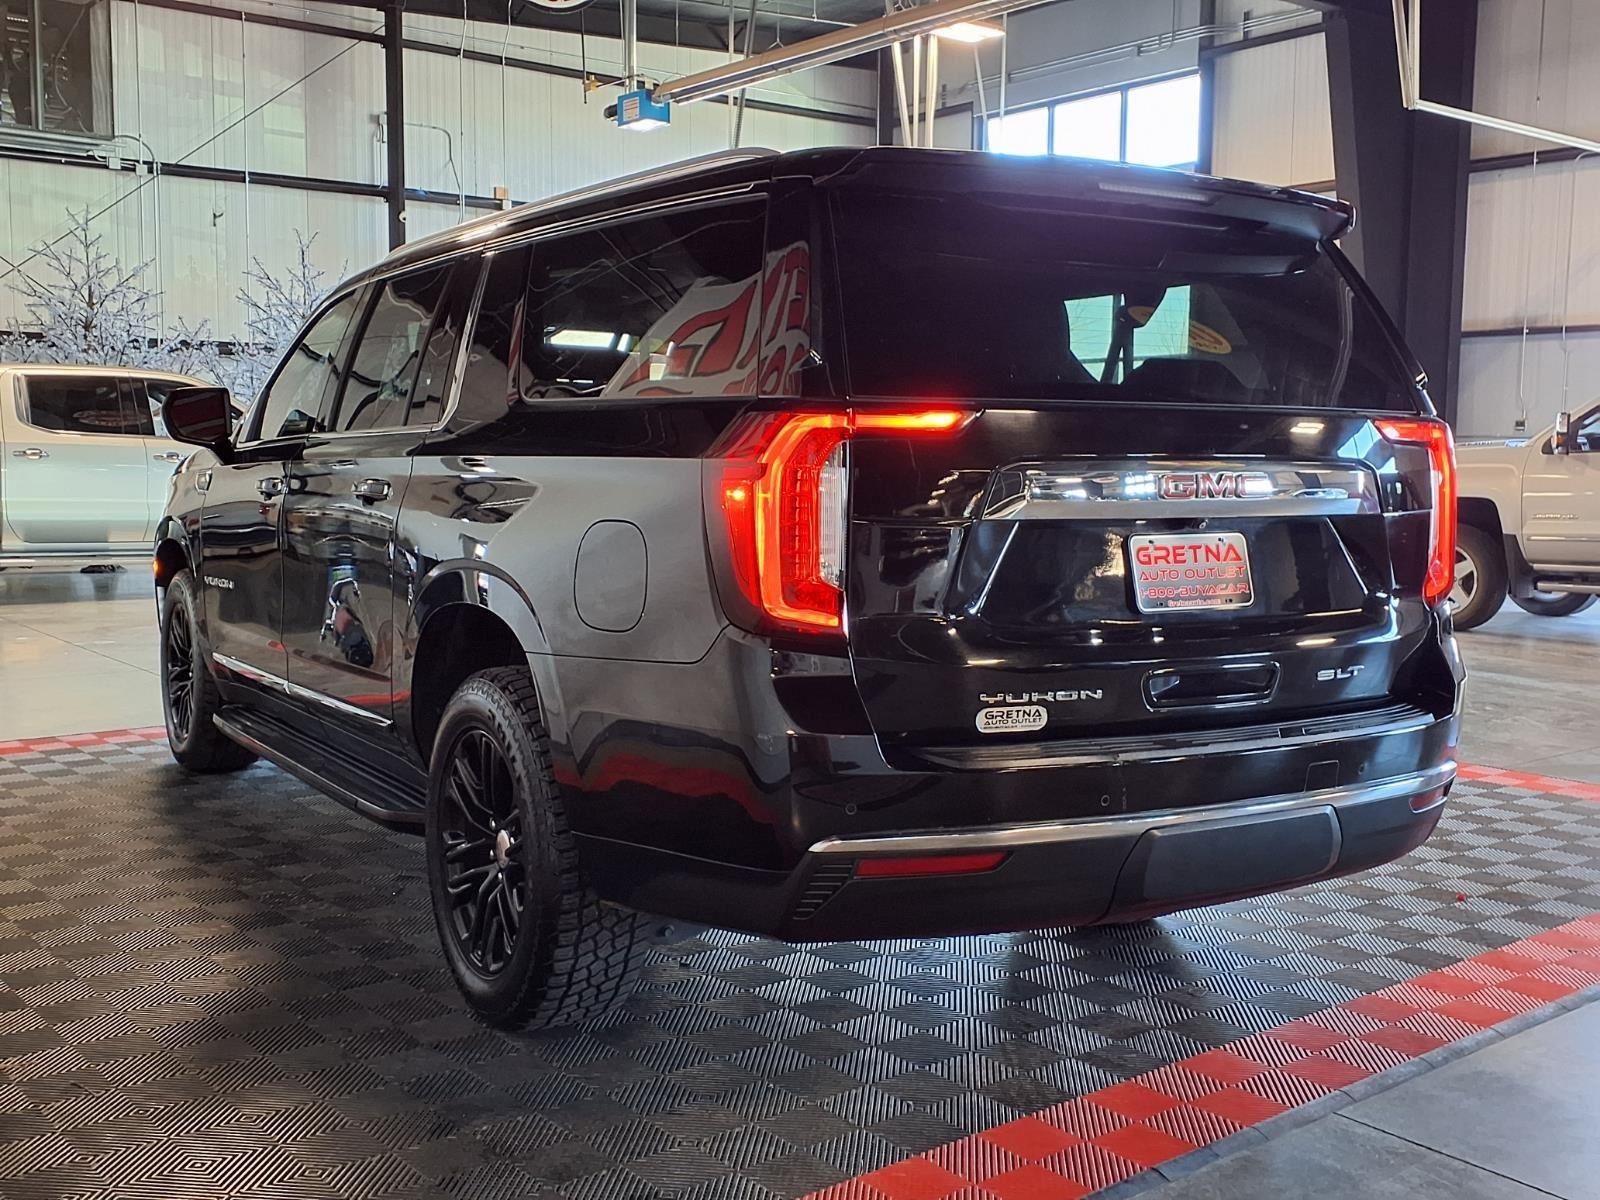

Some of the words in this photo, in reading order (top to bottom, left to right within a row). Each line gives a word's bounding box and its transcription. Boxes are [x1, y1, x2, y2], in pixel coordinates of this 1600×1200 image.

[1159, 472, 1271, 499] GMC
[1136, 543, 1243, 566] GRETNA
[1140, 569, 1180, 581] AUTO
[1184, 565, 1246, 580] OUTLET
[1317, 665, 1365, 680] SLT
[979, 689, 1103, 704] YUKON
[984, 708, 1043, 720] GRETNA
[1010, 717, 1043, 725] OUTLET
